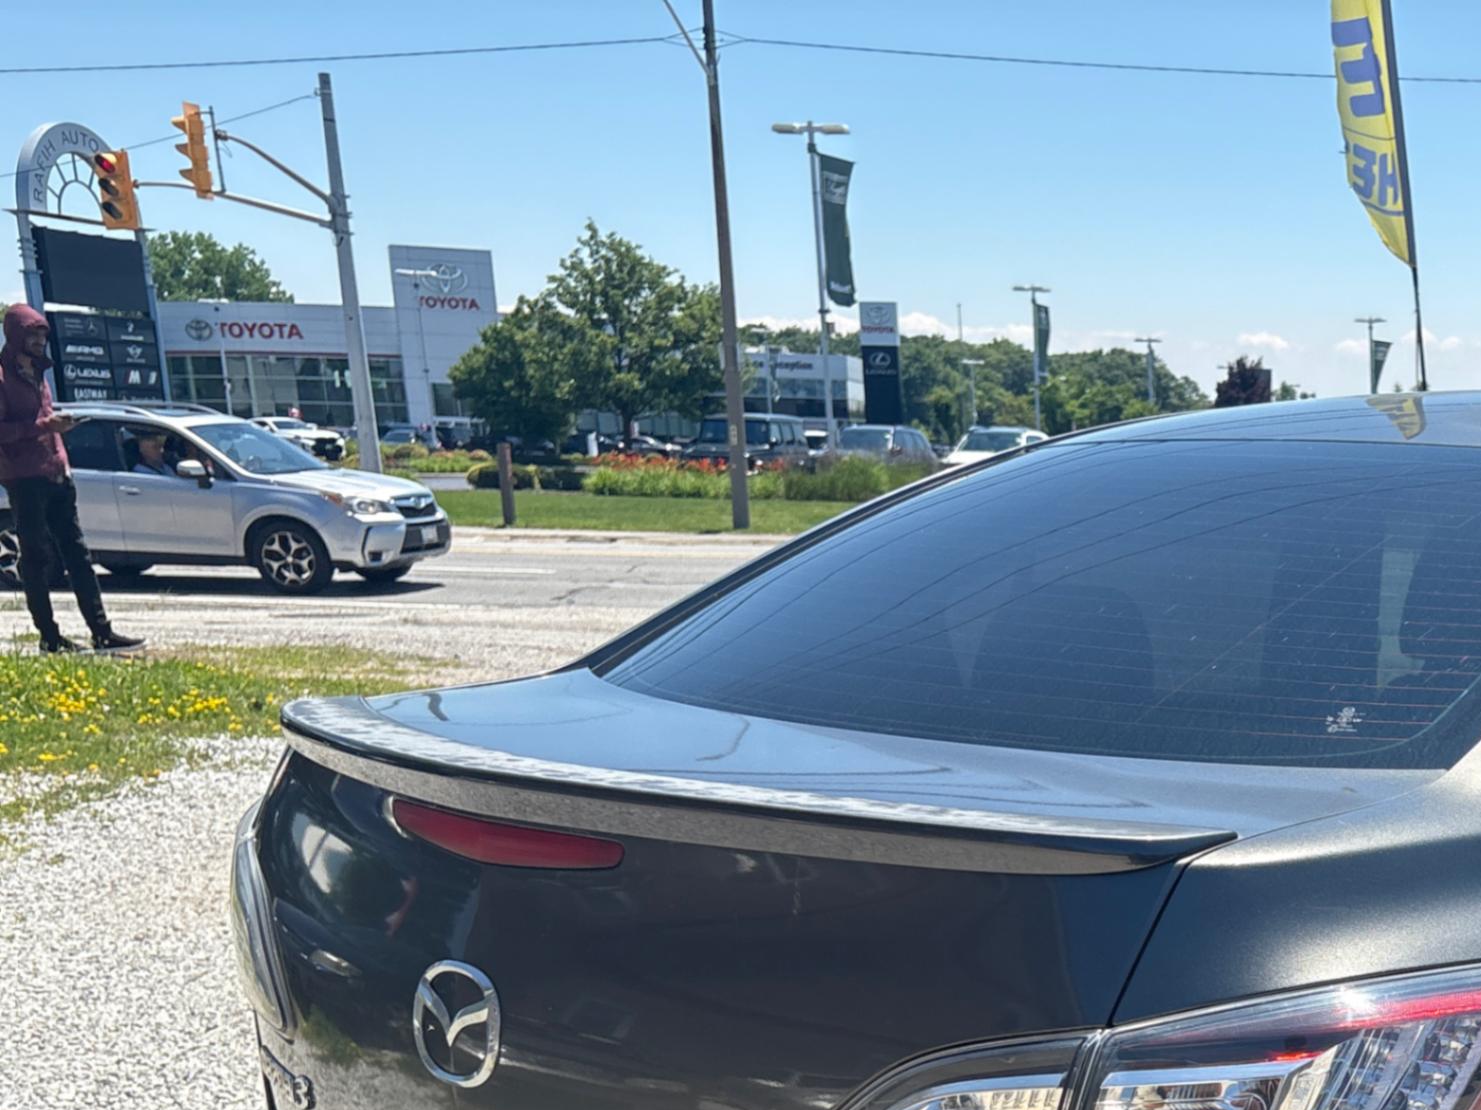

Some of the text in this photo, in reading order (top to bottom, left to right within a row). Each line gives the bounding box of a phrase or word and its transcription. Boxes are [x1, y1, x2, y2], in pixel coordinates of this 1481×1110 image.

[32, 129, 100, 203] RAFIH AUTO
[417, 295, 480, 311] TOYOTA
[219, 322, 304, 340] TOYOTA
